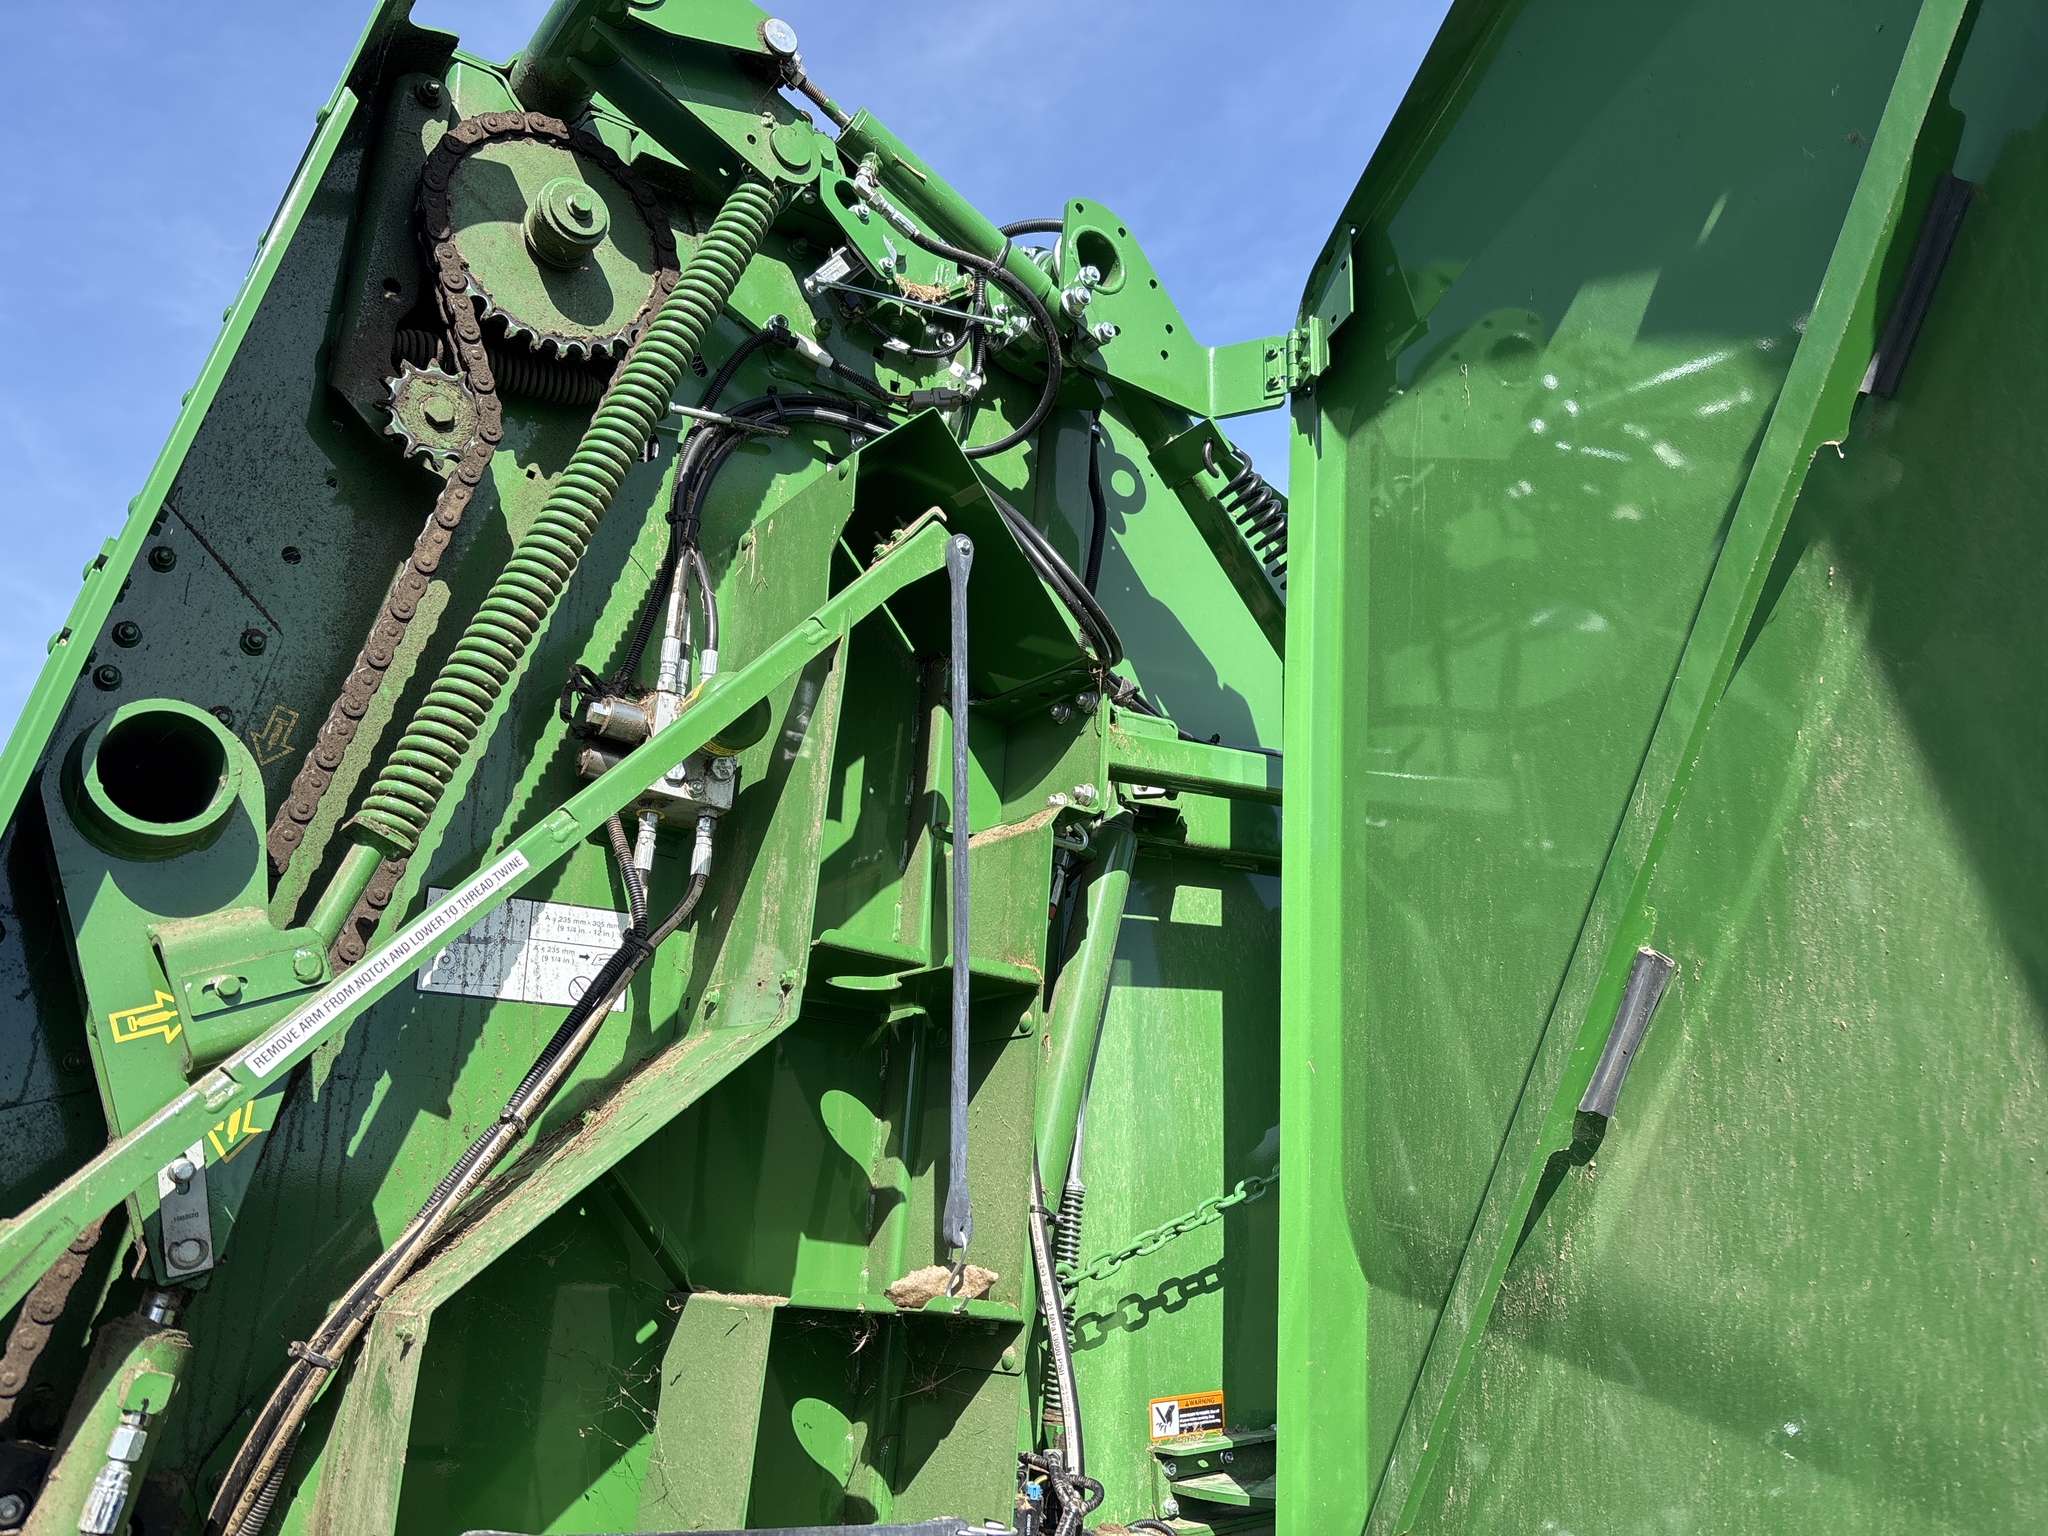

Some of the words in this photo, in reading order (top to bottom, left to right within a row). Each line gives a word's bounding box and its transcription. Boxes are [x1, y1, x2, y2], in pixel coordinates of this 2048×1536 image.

[557, 925, 565, 933] (9
[558, 916, 572, 924] 235
[593, 920, 605, 928] 305
[547, 946, 560, 954] 235
[251, 1027, 301, 1069] REMOVE
[297, 1007, 325, 1033] ARM
[322, 983, 356, 1013] FROM
[353, 957, 390, 989] NOTCH
[387, 940, 411, 962] AND
[409, 914, 445, 946] LOWER
[442, 904, 459, 920] TO
[456, 876, 494, 909] THREAD
[491, 855, 523, 882] TWINE
[541, 954, 549, 963] (9
[562, 957, 575, 966] in.)
[469, 1154, 492, 1180] (3000
[453, 1179, 472, 1200] PSI)
[1046, 1301, 1053, 1310] 21
[1047, 1313, 1057, 1332] MPa
[1051, 1333, 1062, 1356] (3000
[1056, 1357, 1065, 1375] PSI)
[1190, 1397, 1215, 1406] WARNING
